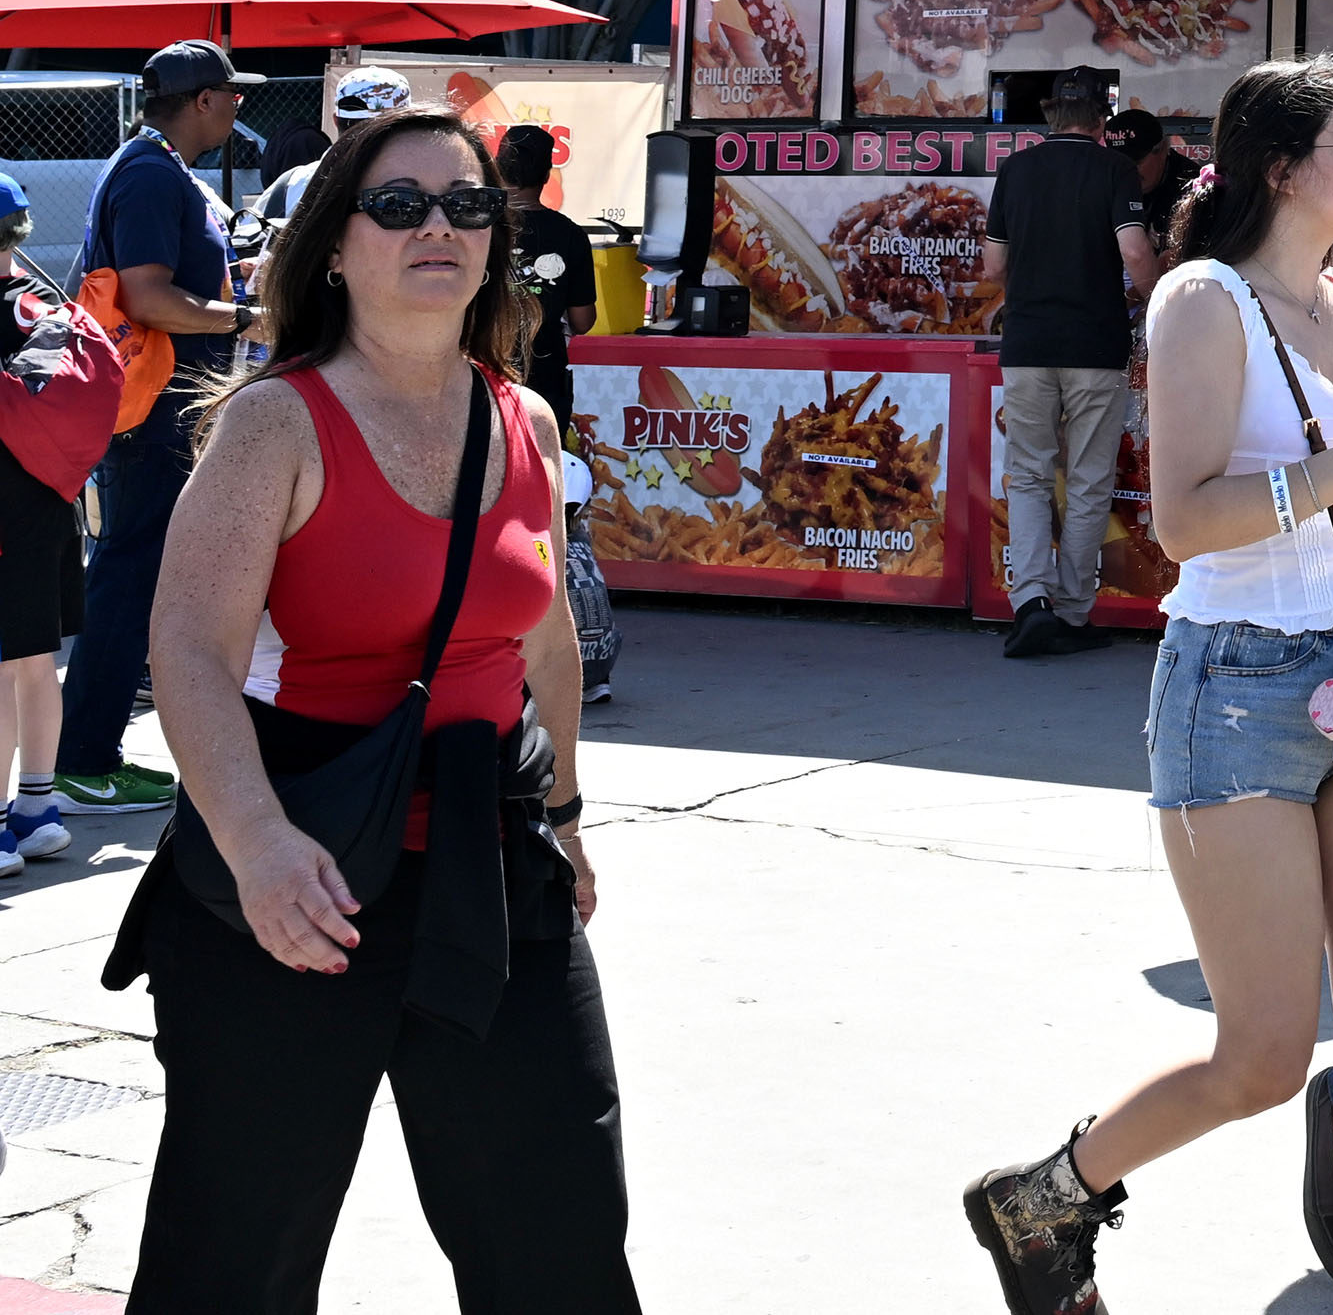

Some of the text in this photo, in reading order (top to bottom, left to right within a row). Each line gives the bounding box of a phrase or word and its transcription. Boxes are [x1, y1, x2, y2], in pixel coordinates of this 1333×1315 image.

[945, 8, 983, 16] AVAILABLE
[694, 67, 782, 85] CHILI CHEESE
[720, 86, 753, 104] DOG
[715, 132, 840, 172] OTED
[852, 131, 974, 172] BEST
[601, 208, 626, 221] 1939
[869, 236, 976, 257] BACON RANCH
[901, 256, 941, 276] FRIES
[622, 405, 750, 453] PINK'S
[808, 454, 870, 467] NOT AVAILABLE
[1278, 485, 1288, 513] Modelo
[805, 526, 914, 552] BACON NACHO
[838, 548, 878, 570] FRIES
